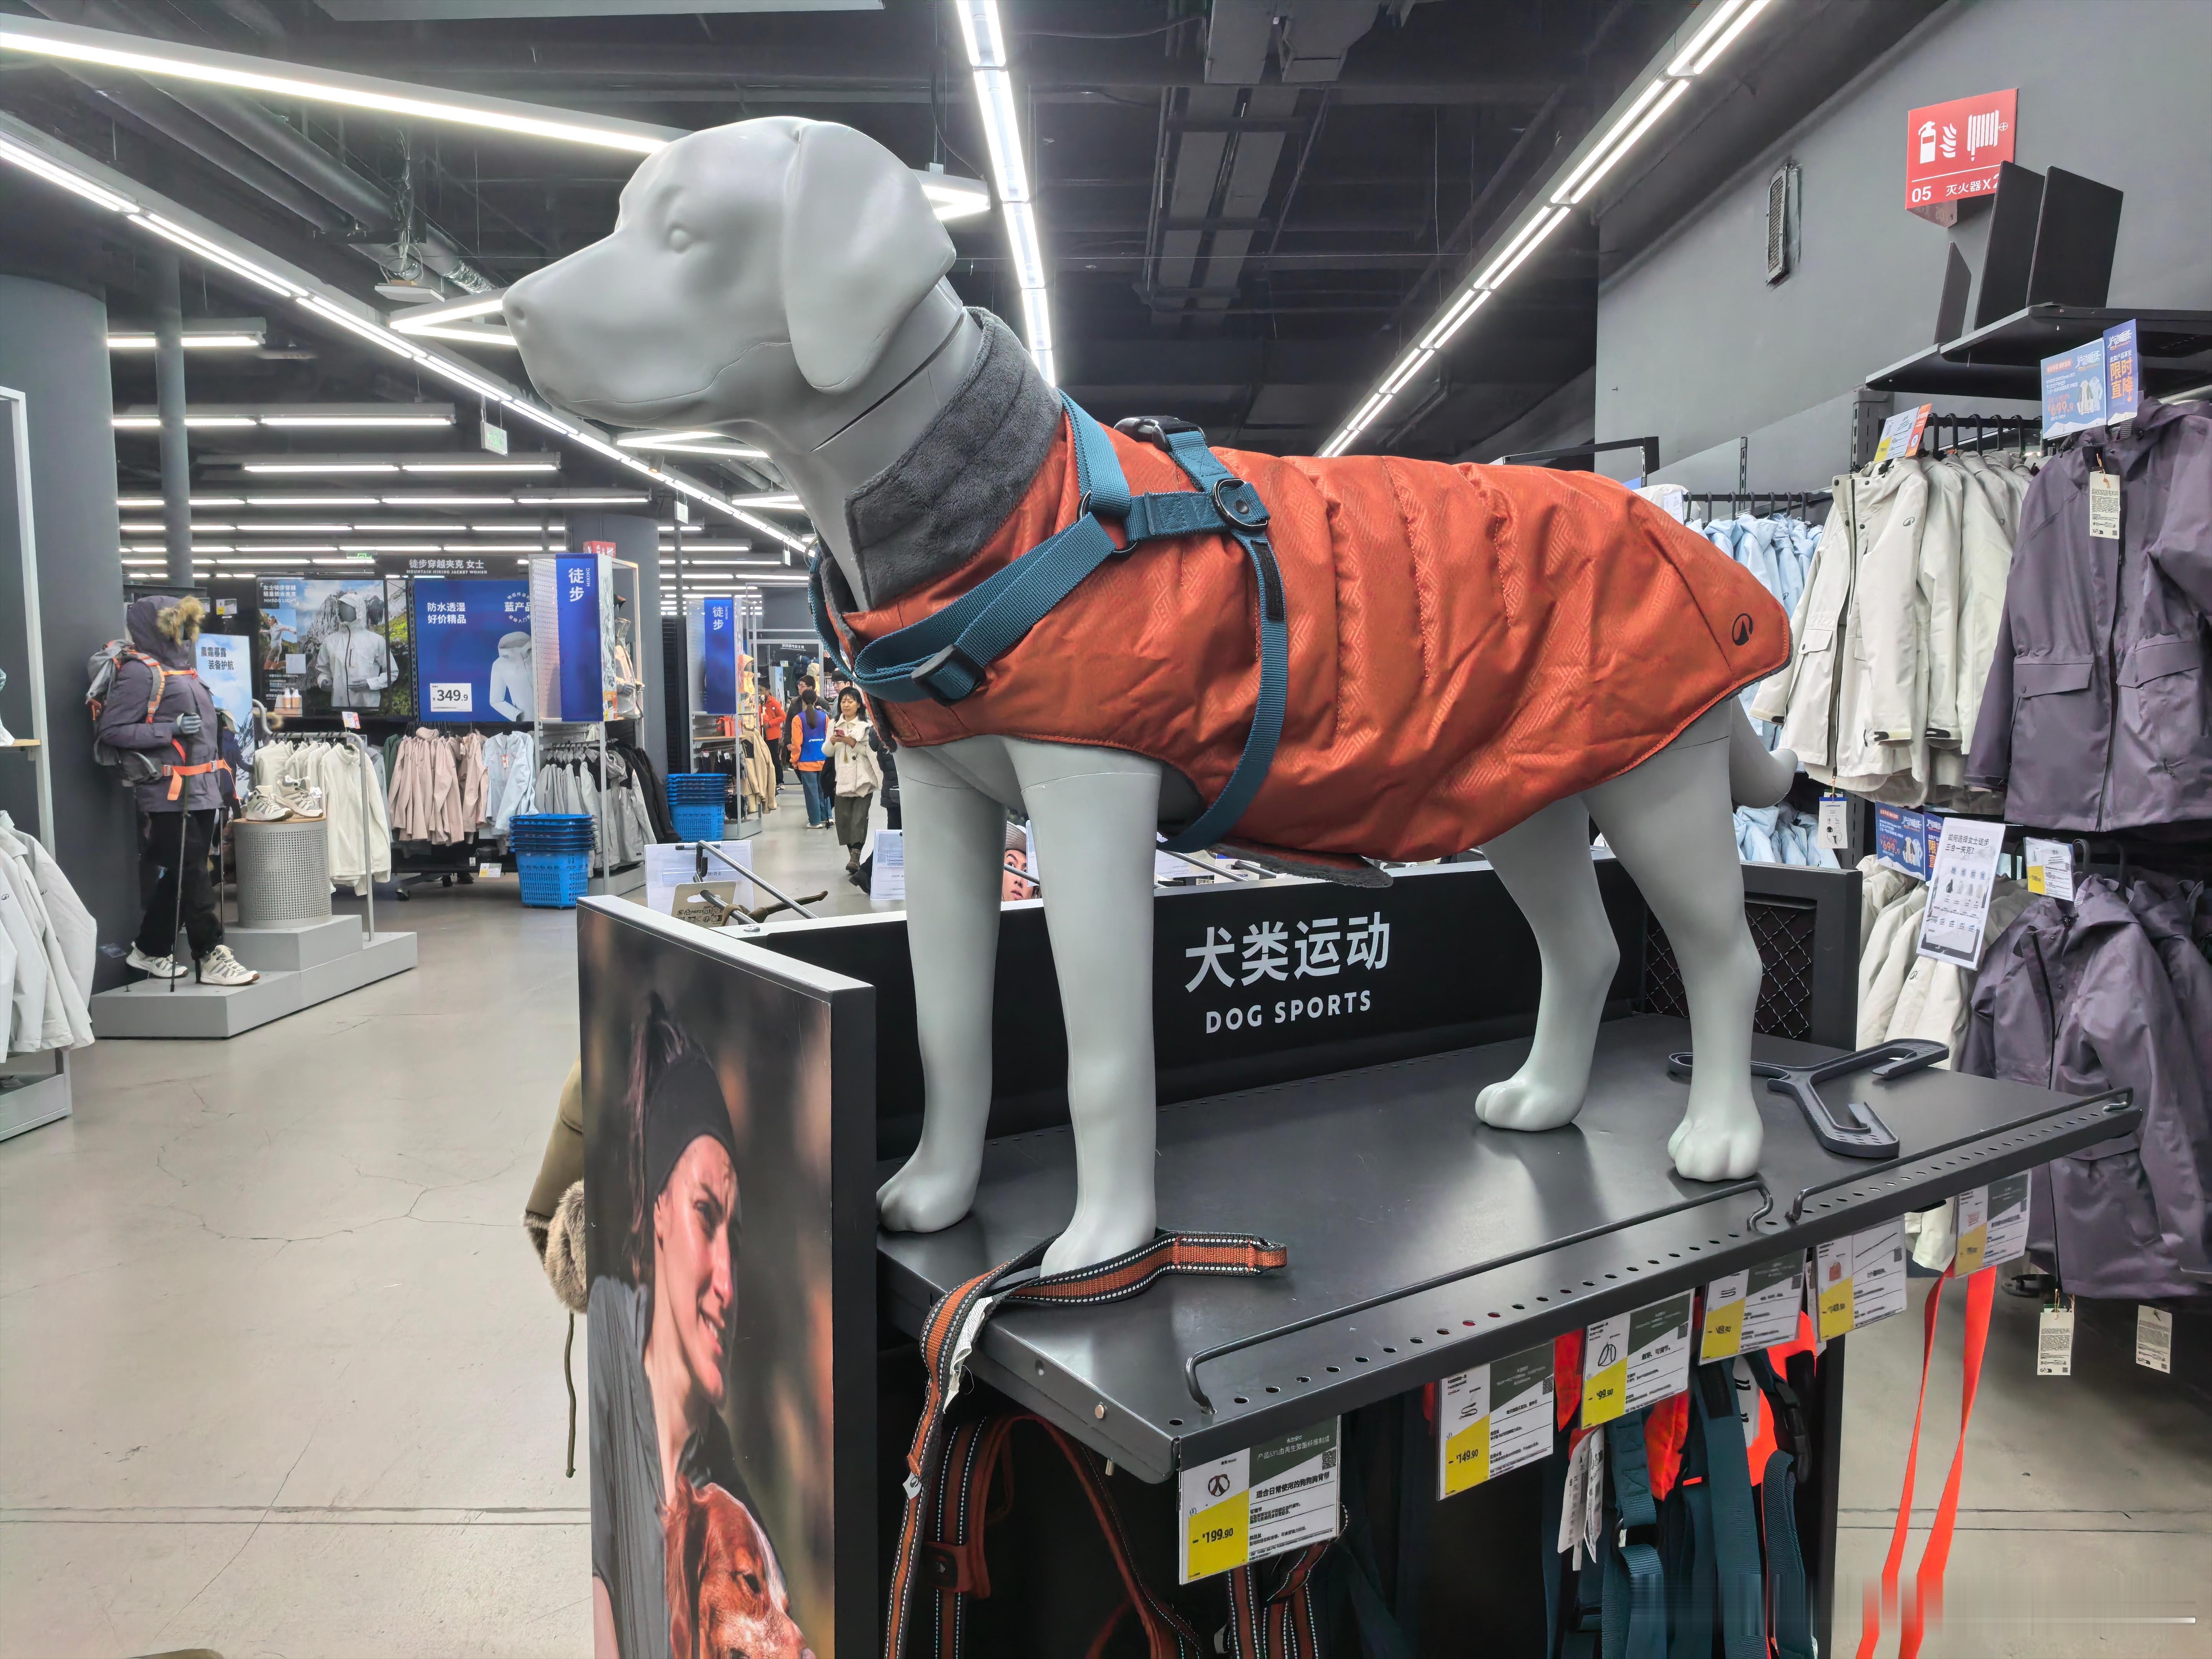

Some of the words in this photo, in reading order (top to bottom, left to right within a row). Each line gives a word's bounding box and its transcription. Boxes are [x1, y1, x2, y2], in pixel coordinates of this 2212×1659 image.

[1912, 185, 1931, 202] 05
[2110, 356, 2132, 381] 限时
[2111, 376, 2133, 402] 直降
[409, 559, 464, 569] 徒步穿越夹克
[466, 560, 484, 569] 女士
[568, 568, 584, 602] 徒步
[427, 602, 466, 612] 防水透湿
[427, 614, 467, 624] 好价精品
[713, 606, 724, 630] 徒步
[208, 660, 234, 670] 装备护航
[1185, 911, 1390, 993] 犬类运动
[1206, 1005, 1262, 1034] DOG
[1275, 990, 1371, 1023] SPORTS
